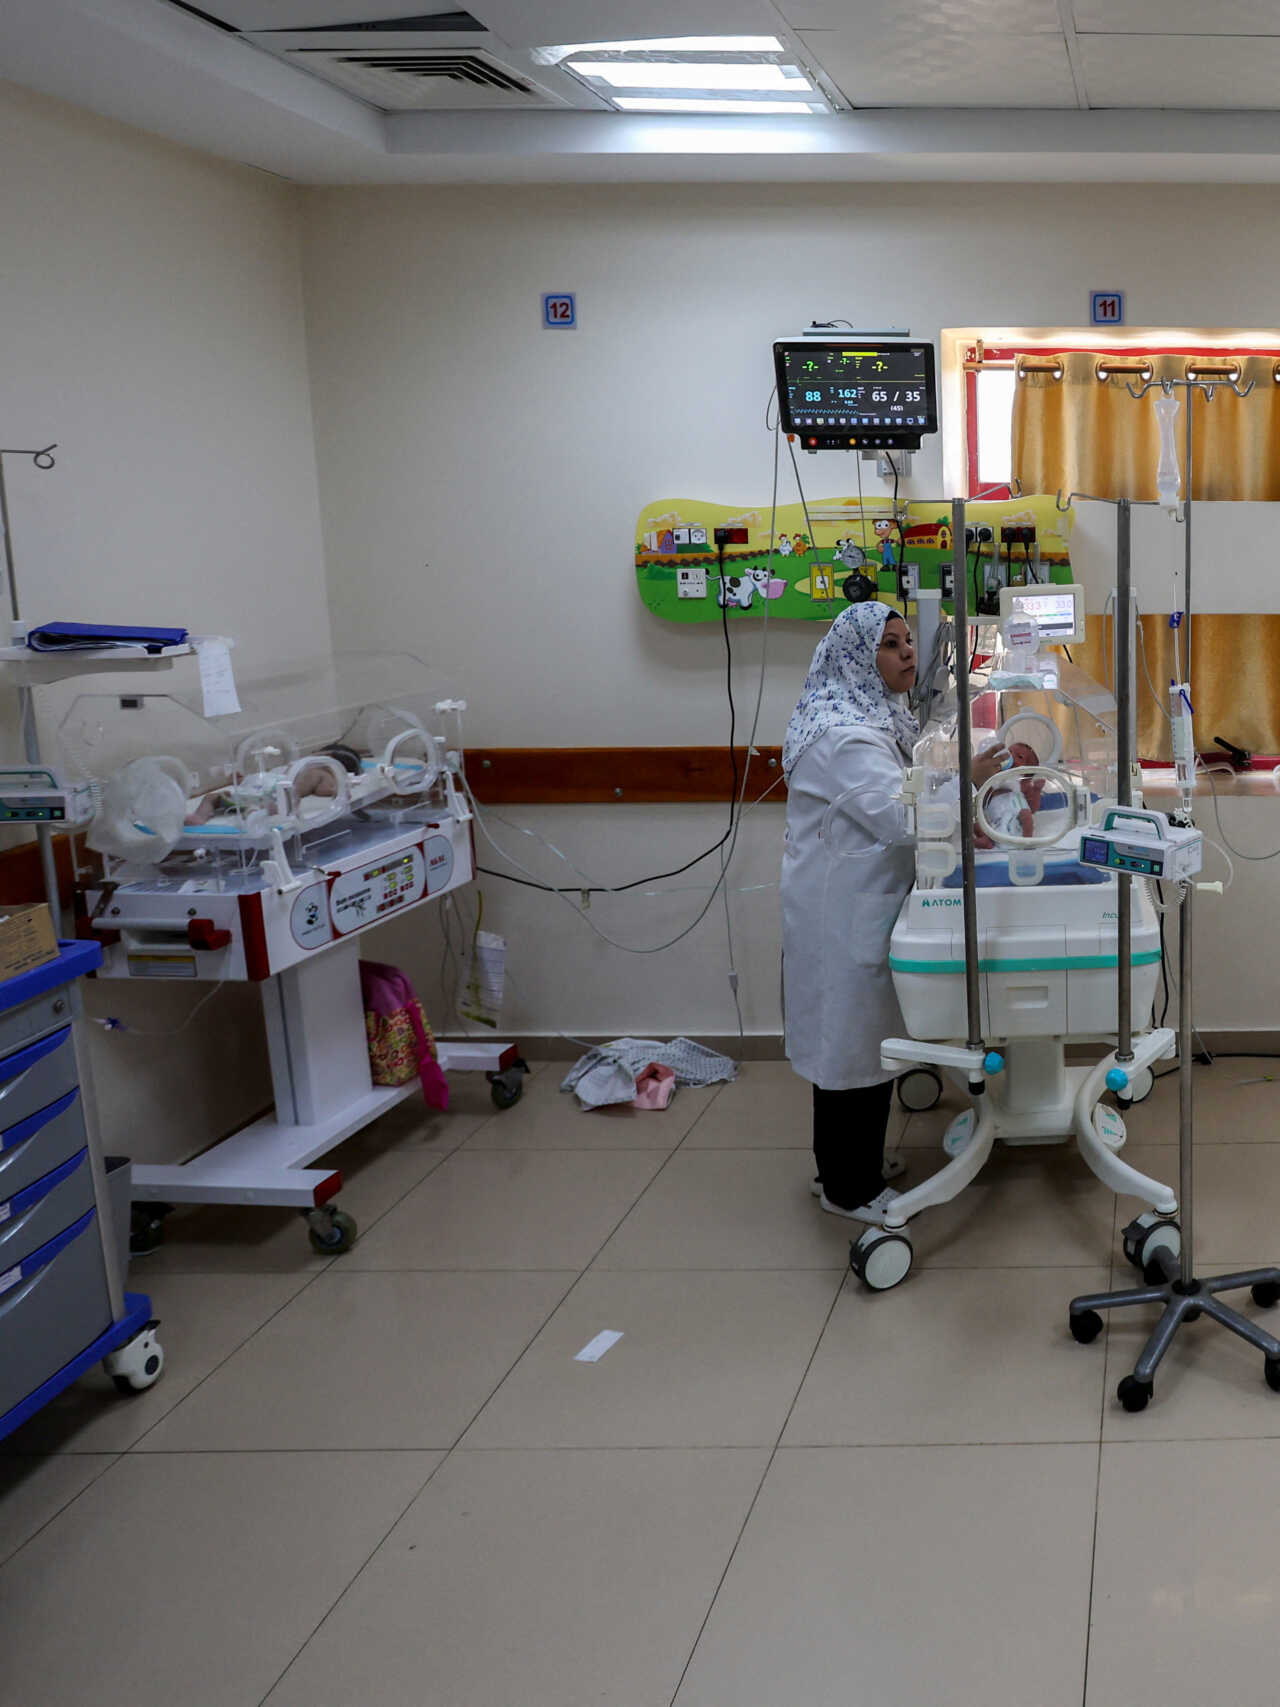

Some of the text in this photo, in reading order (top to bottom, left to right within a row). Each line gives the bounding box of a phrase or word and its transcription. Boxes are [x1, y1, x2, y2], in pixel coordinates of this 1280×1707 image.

[549, 302, 570, 319] 12
[1099, 300, 1115, 317] 11
[805, 391, 821, 402] 88
[838, 389, 857, 398] 162
[872, 391, 888, 402] 65
[905, 391, 921, 402] 35
[932, 898, 962, 907] ATOM
